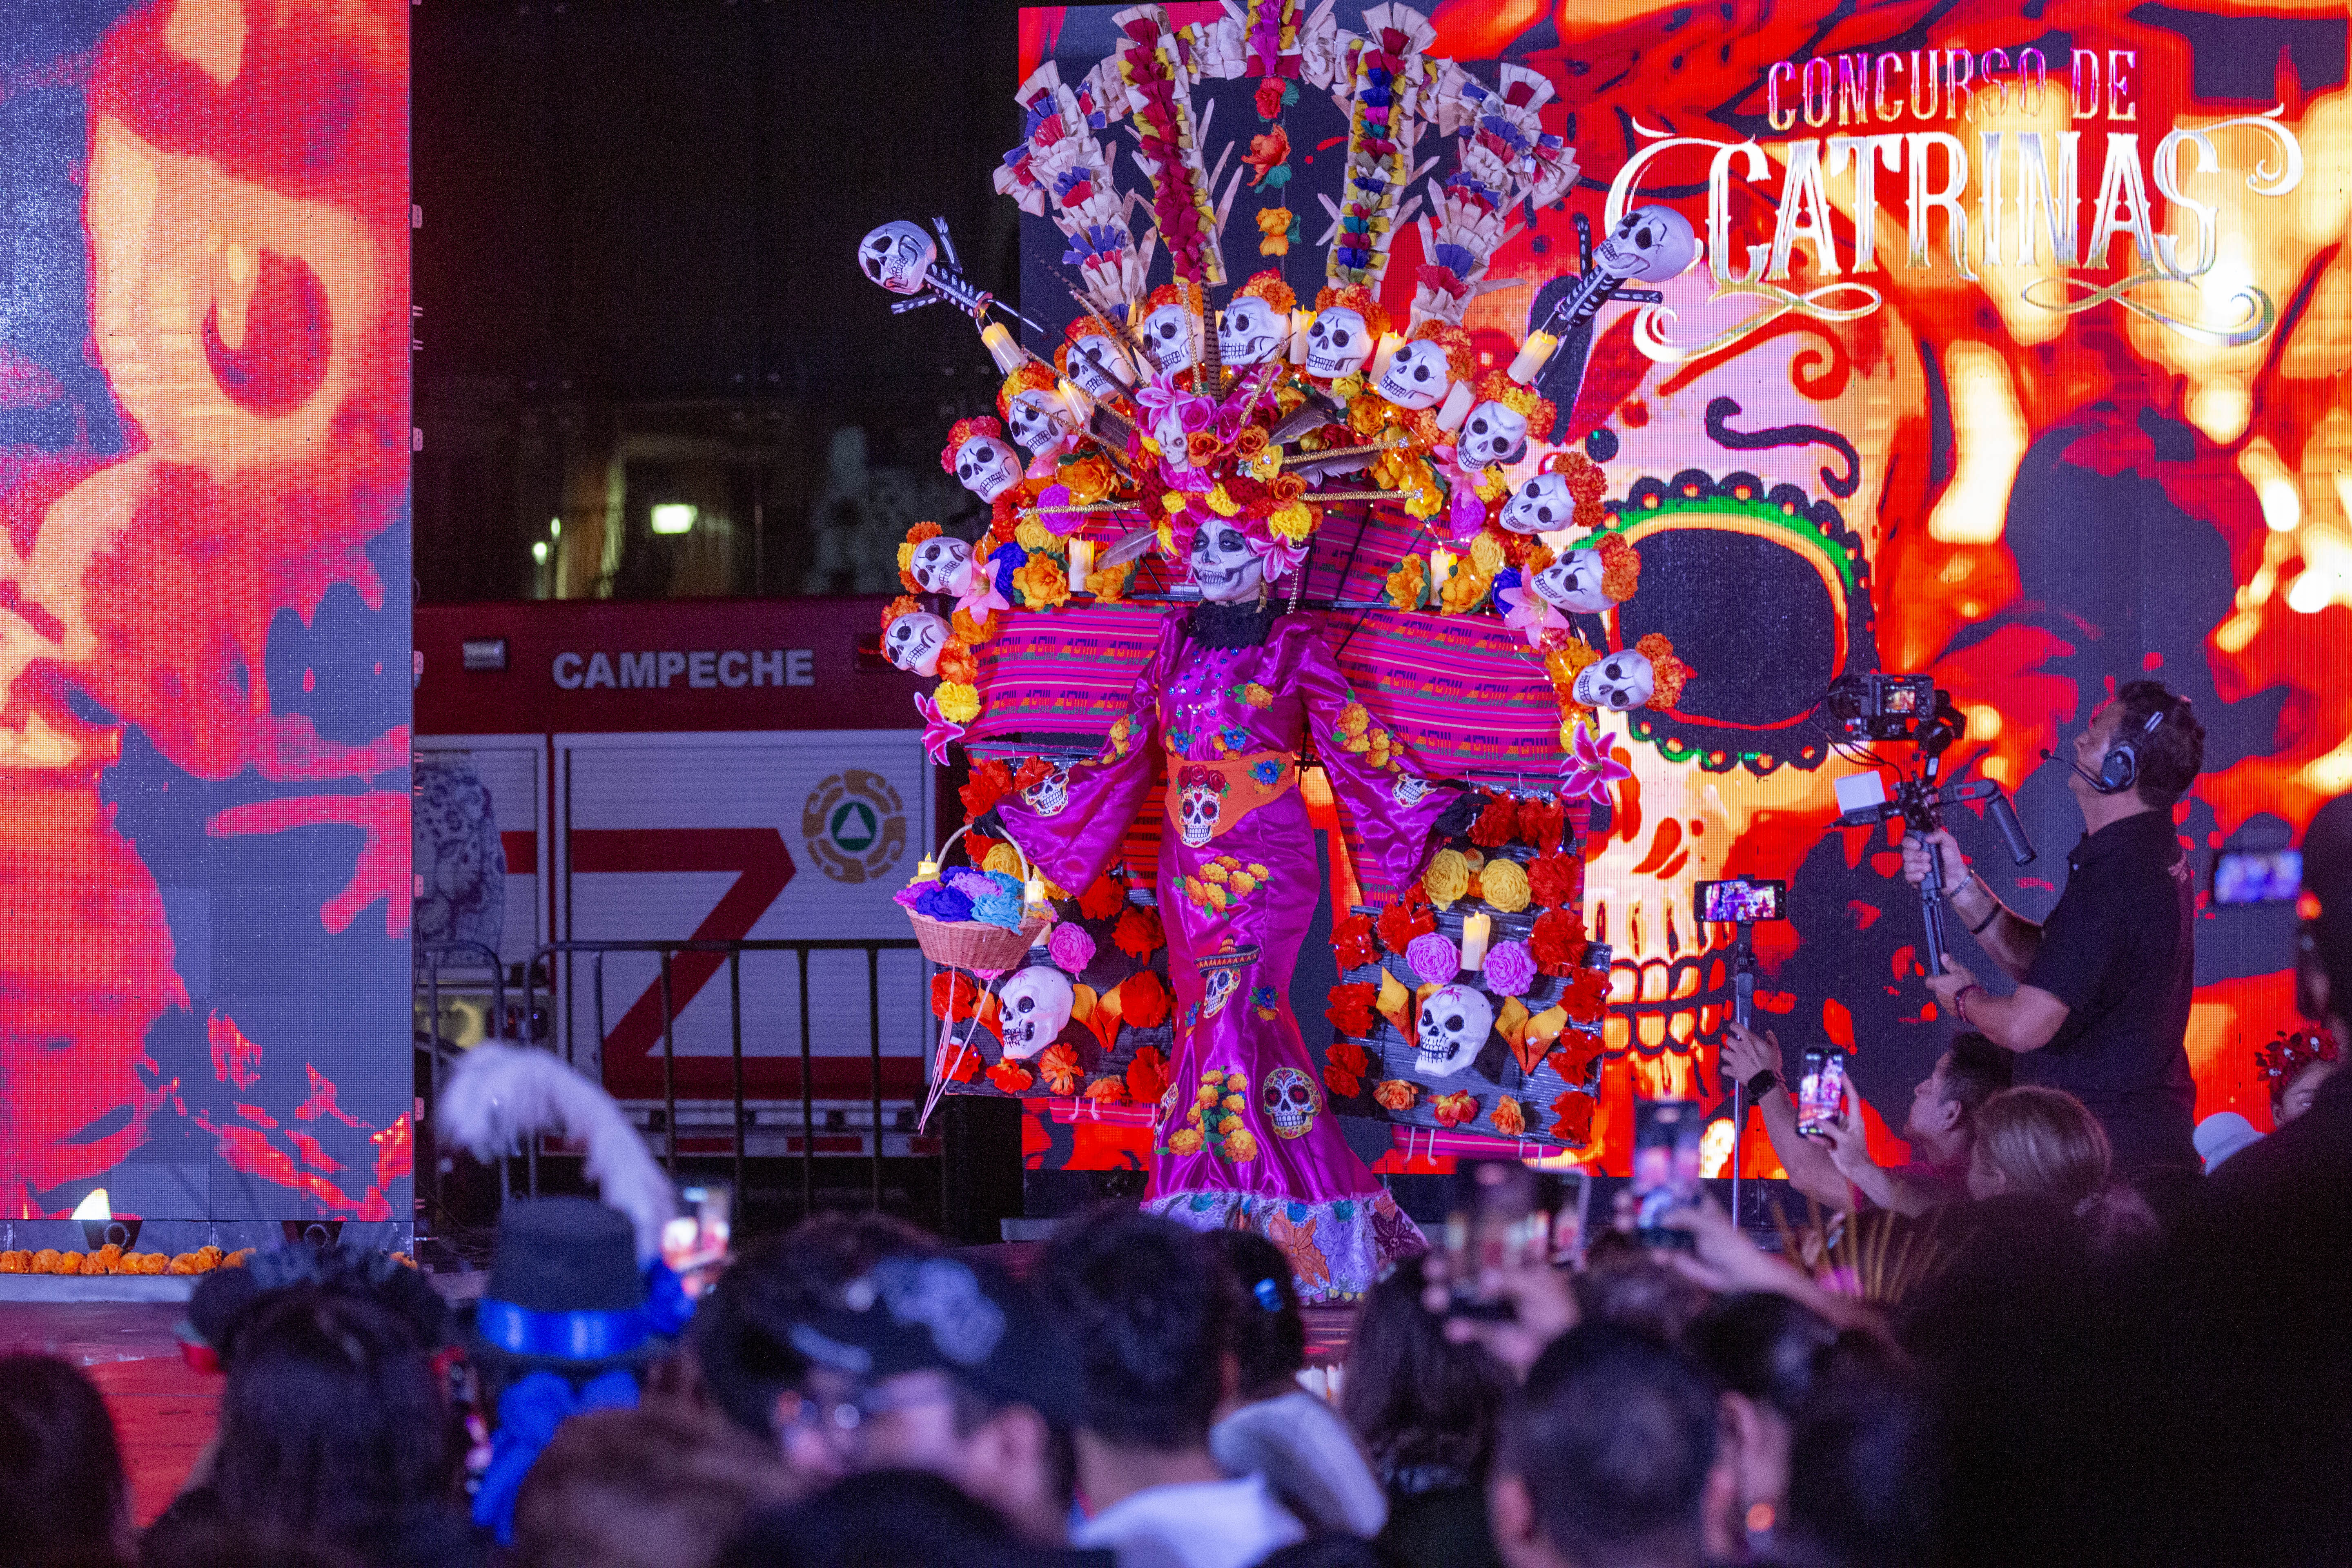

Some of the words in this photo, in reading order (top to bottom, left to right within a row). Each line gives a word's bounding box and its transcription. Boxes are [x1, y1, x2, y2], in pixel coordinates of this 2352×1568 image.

[1768, 47, 2046, 131] CONCURSO
[2070, 48, 2137, 121] DE
[1604, 103, 2303, 288] CATRINAS
[552, 649, 814, 689] CAMPECHE
